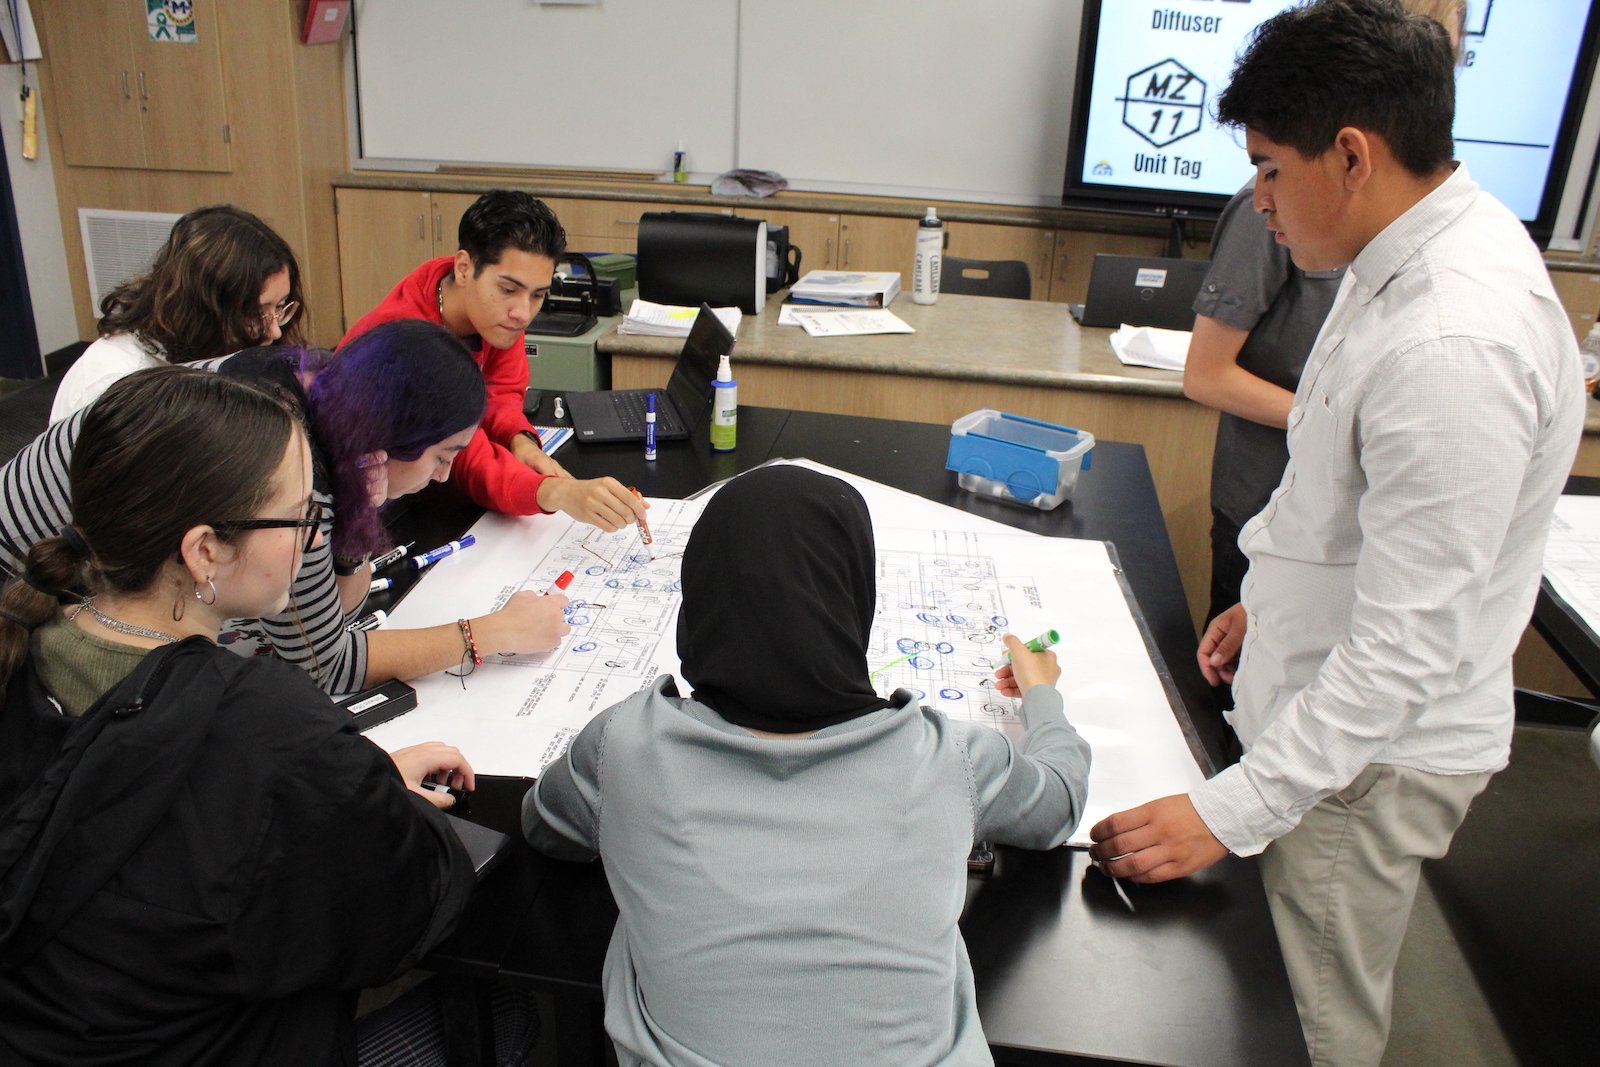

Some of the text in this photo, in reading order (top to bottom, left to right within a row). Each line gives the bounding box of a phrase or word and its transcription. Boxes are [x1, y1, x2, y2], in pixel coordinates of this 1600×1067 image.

[1152, 9, 1223, 33] Diffuser
[1145, 73, 1193, 100] MZ
[1150, 109, 1183, 135] 11
[1134, 153, 1202, 180] Unit Tag
